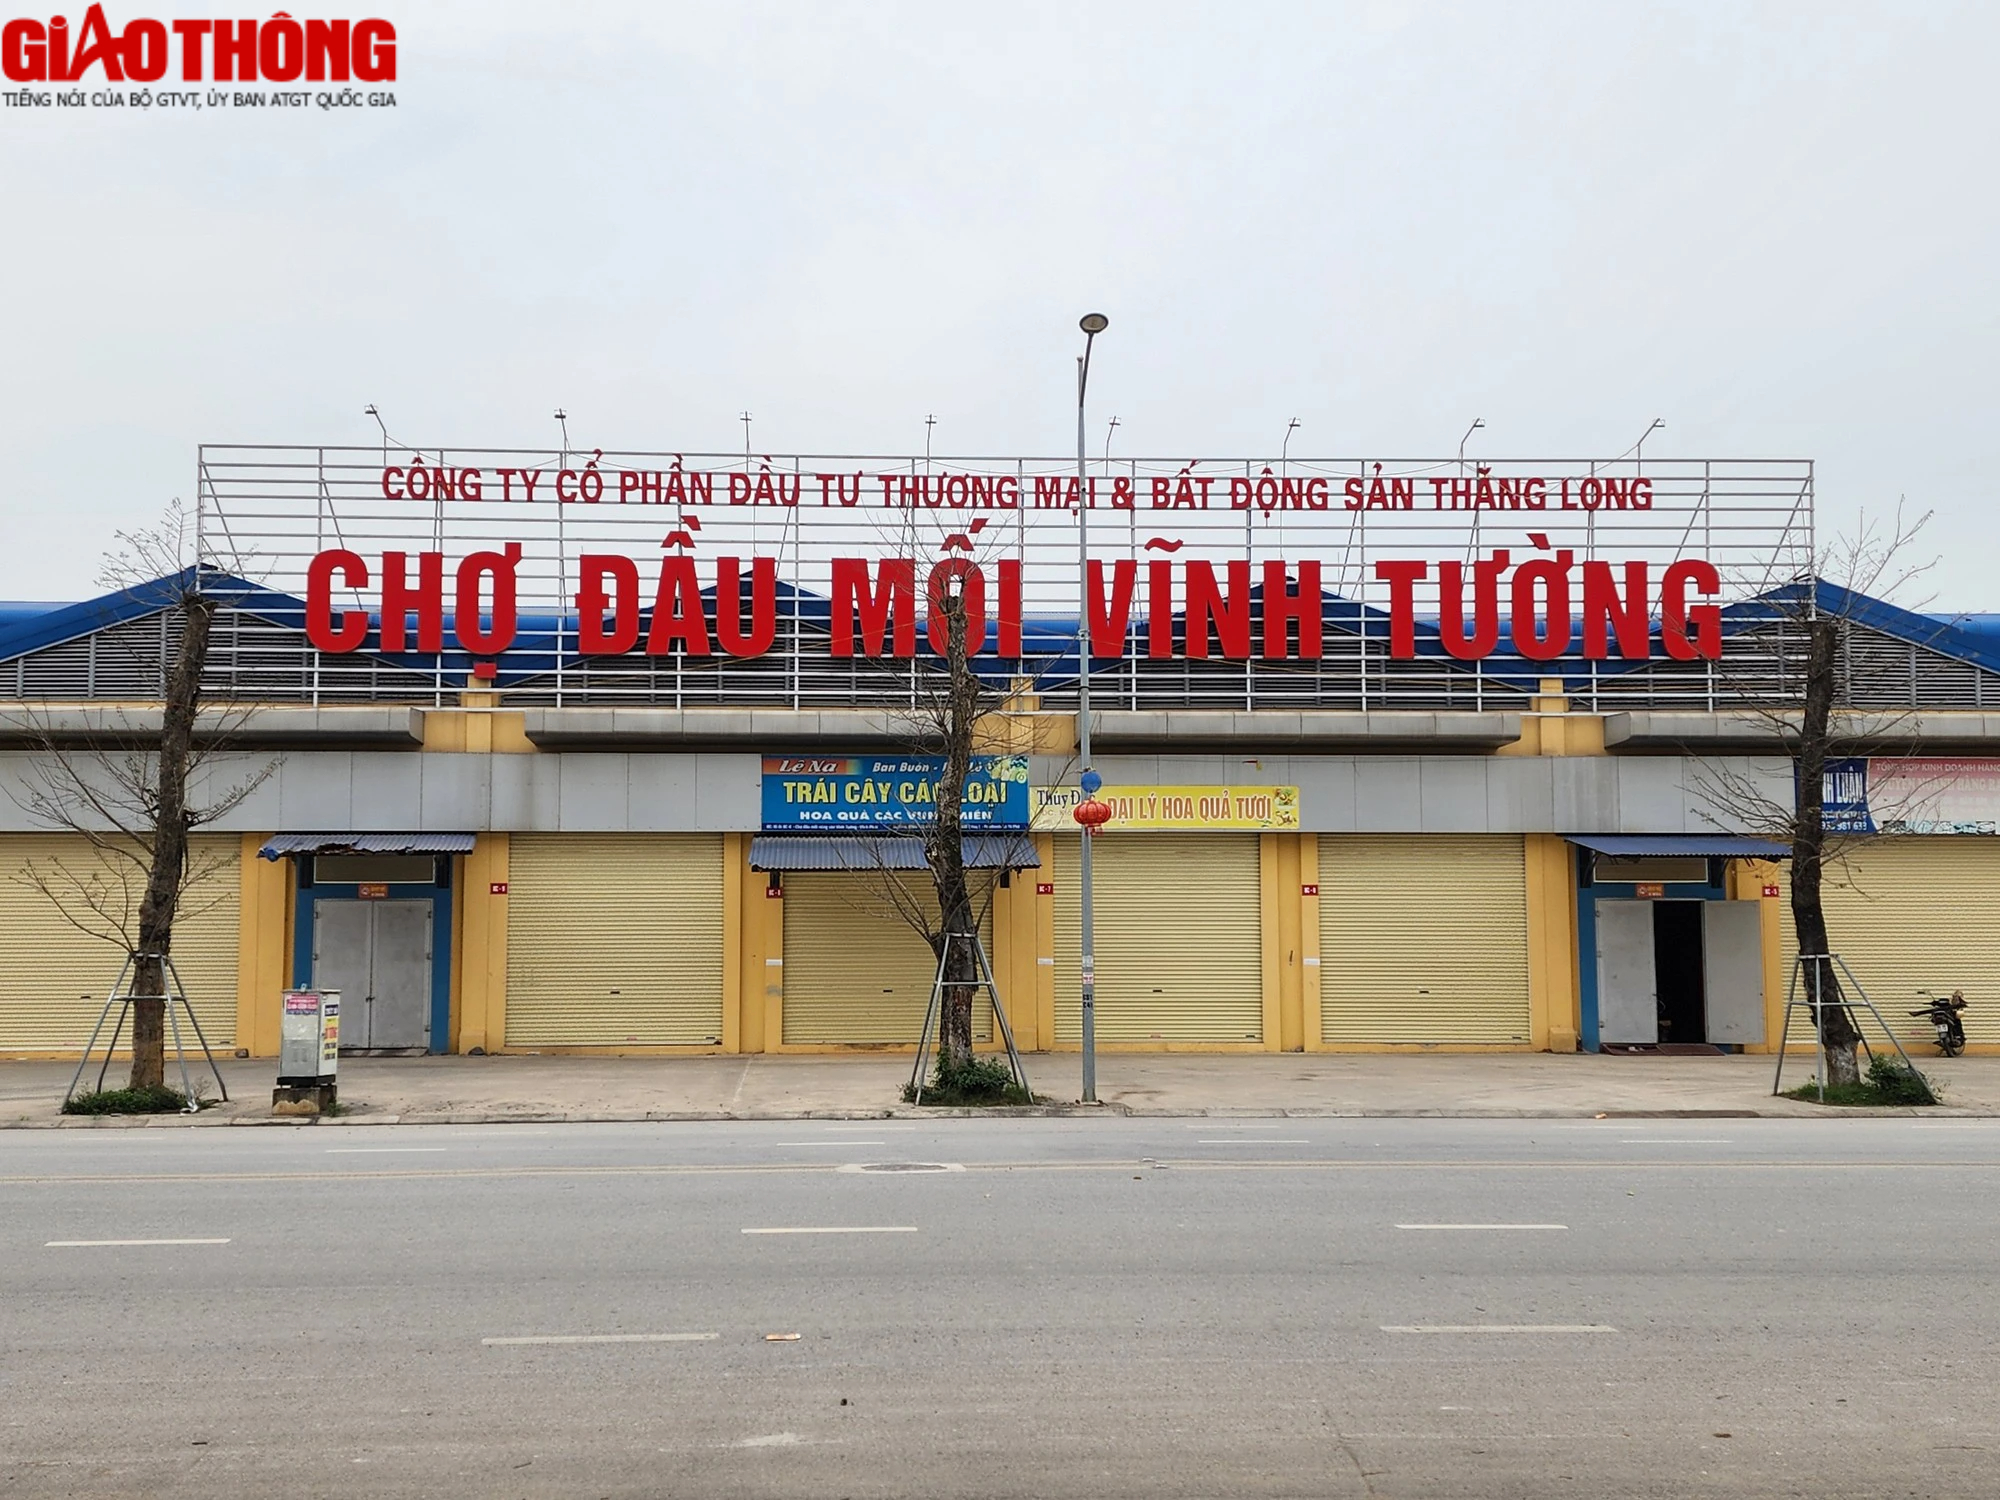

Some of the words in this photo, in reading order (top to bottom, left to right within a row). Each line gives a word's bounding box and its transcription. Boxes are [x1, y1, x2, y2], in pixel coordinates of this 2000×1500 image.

[382, 456, 481, 502] CÔNG
[496, 468, 542, 502] TY
[556, 448, 603, 504] CỔ
[619, 453, 713, 505] PHẦN
[729, 454, 800, 506] ĐẦU
[815, 470, 864, 507] TƯ
[878, 471, 1018, 509] THƯƠNG
[1034, 476, 1096, 516] MẠI
[1111, 476, 1135, 510] &
[1152, 458, 1214, 510] BẤT
[1228, 466, 1329, 518] ĐỘNG
[1344, 462, 1414, 511] SẢN
[1429, 467, 1546, 511] THĂNG
[1562, 477, 1653, 511] LONG
[305, 542, 523, 679] CHỢ
[575, 515, 776, 657] ĐẦU
[830, 518, 1021, 658] MỐI
[1086, 537, 1322, 660] VĨNH
[1376, 533, 1722, 661] TƯỜNG
[779, 758, 806, 773] Lê
[807, 759, 838, 773] Na
[1922, 762, 1943, 772] KINH
[783, 777, 837, 803] TRÁI
[845, 777, 892, 803] CÂY
[800, 811, 832, 821] HOA
[1107, 797, 1134, 825] ĐẠI
[1138, 793, 1157, 819] LÝ
[1162, 798, 1195, 819] HOA
[1199, 790, 1232, 822] QUẢ
[1236, 795, 1272, 820] TƯƠI
